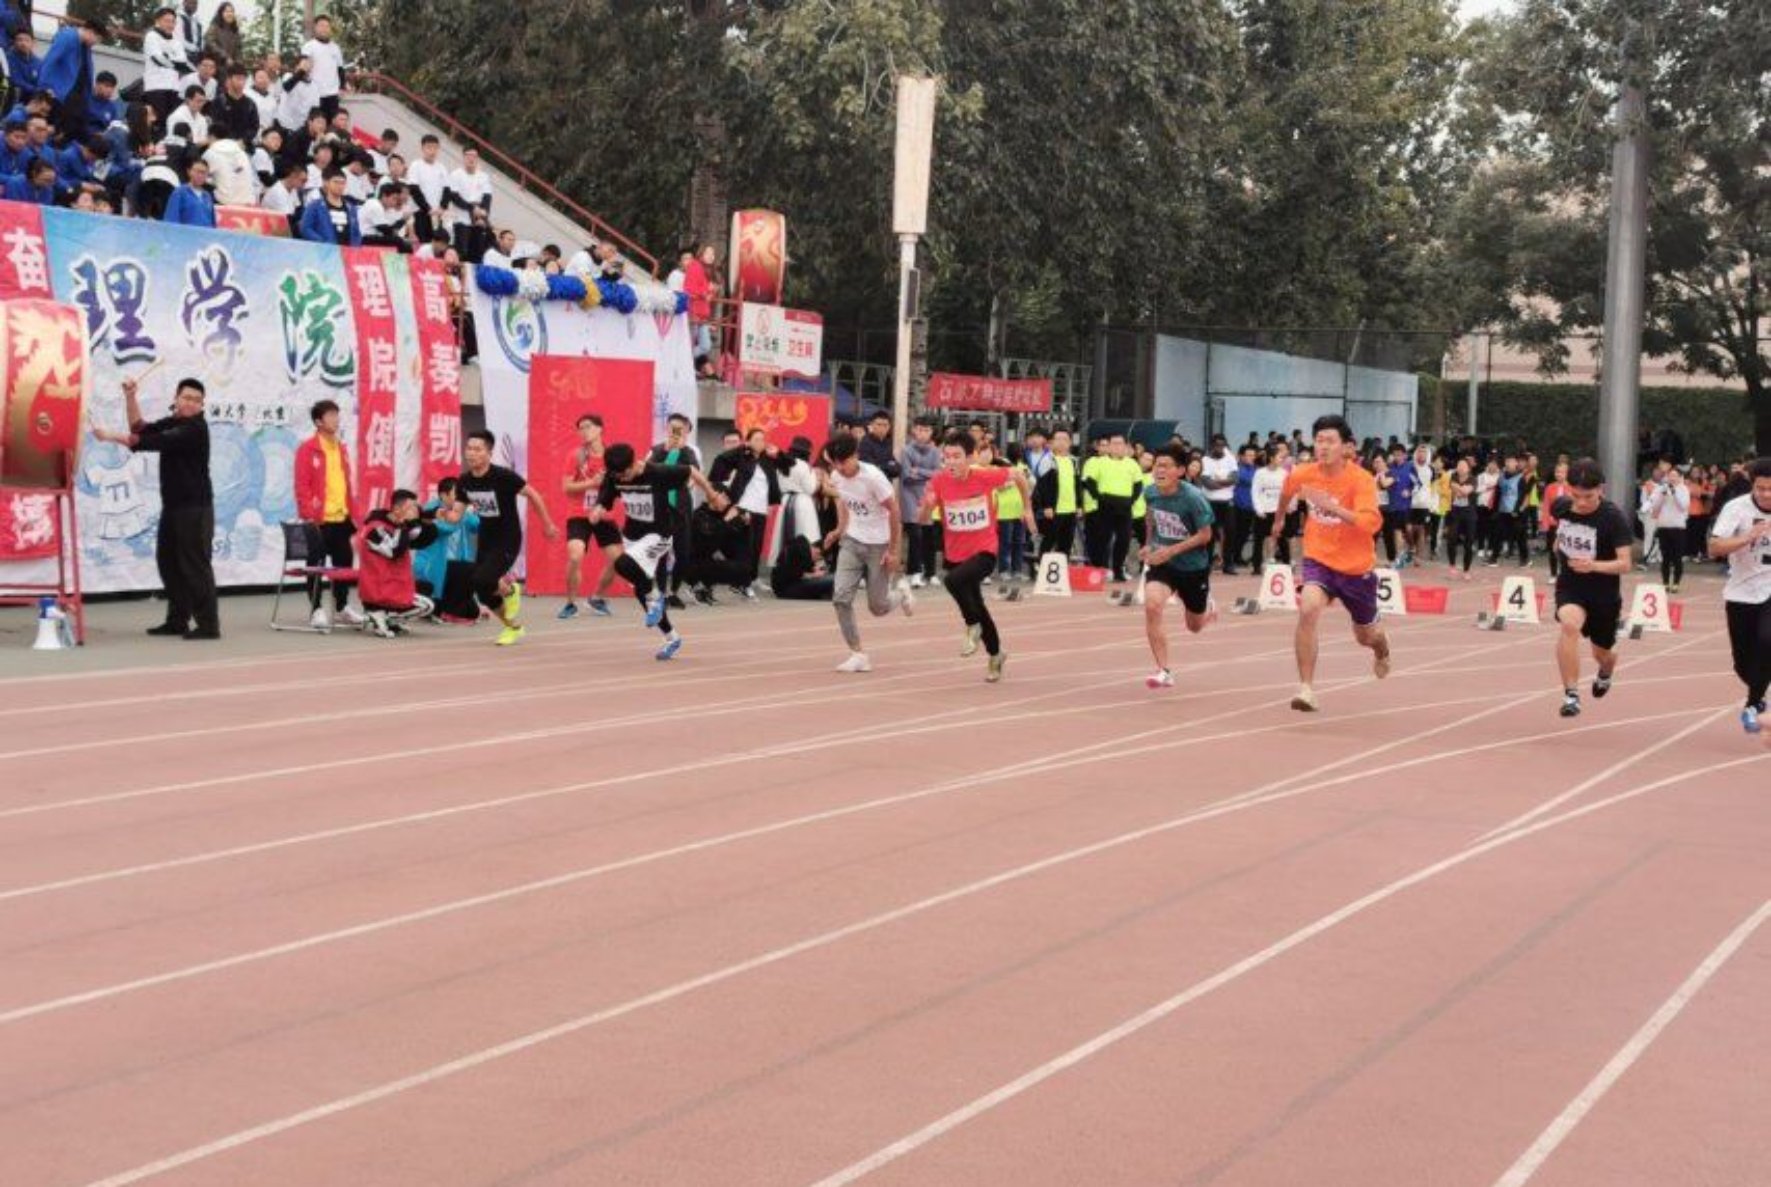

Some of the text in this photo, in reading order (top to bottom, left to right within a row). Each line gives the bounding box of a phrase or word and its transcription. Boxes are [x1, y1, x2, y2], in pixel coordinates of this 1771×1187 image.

[3, 228, 48, 290] 奋
[72, 245, 357, 387] 理学院
[418, 271, 461, 502] 高奏凯
[948, 510, 986, 526] 2104
[1046, 562, 1060, 584] 8
[1270, 573, 1285, 596] 6
[1378, 577, 1392, 601] 5
[1509, 585, 1525, 609] 4
[1642, 593, 1657, 618] 3
